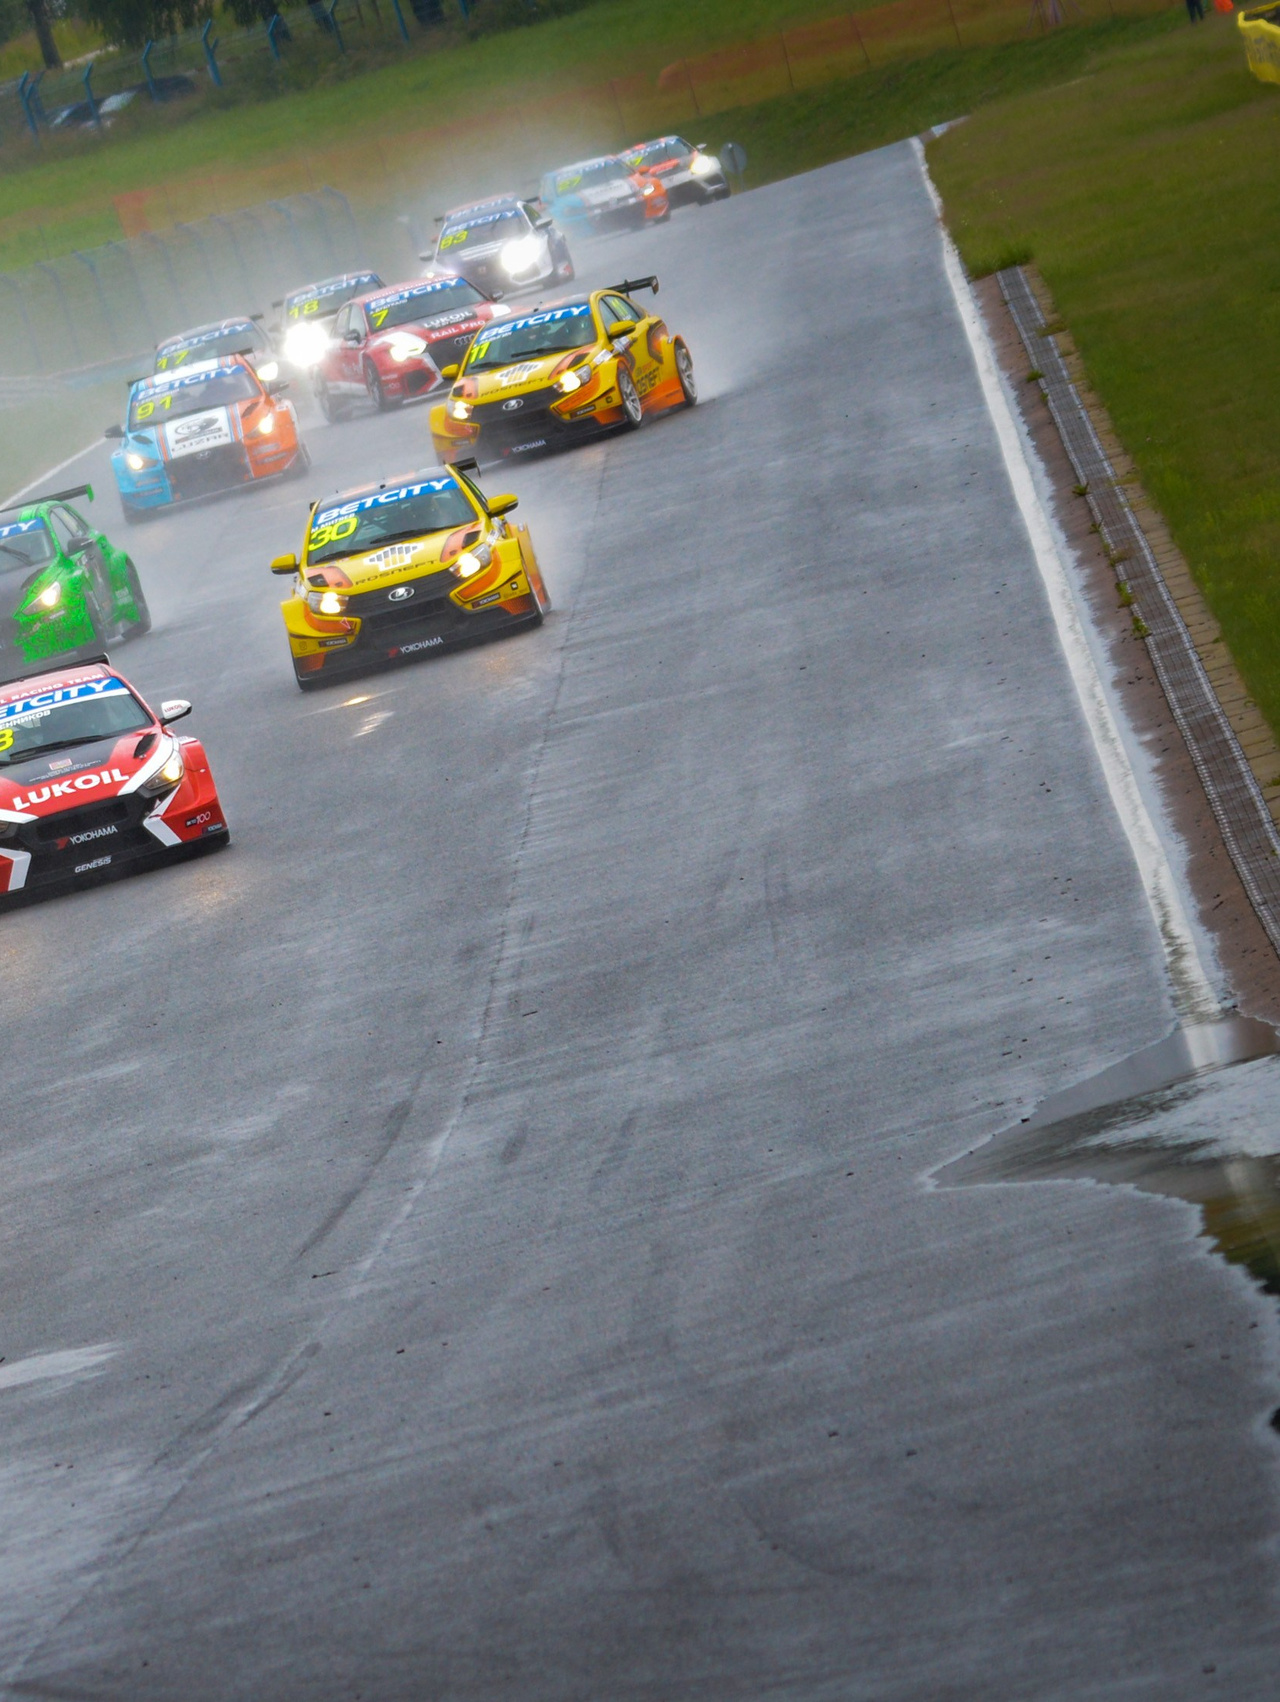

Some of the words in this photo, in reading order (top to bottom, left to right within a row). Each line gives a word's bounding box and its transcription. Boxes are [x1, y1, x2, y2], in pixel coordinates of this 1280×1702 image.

[440, 229, 469, 250] 83
[370, 278, 459, 310] BETCITY
[289, 299, 319, 319] 18
[372, 307, 389, 328] 7
[423, 310, 473, 328] LUKOIL
[431, 328, 459, 340] RAIL
[460, 320, 485, 332] PRO
[480, 305, 588, 341] BETCITY
[157, 350, 190, 370] 17
[470, 341, 491, 364] 11
[138, 364, 238, 400] BETCITY
[480, 377, 547, 397] ROSNEFT
[136, 395, 173, 421] 91
[512, 439, 547, 454] YOKOHAMA
[317, 478, 452, 525] BETCITY
[308, 516, 359, 551] 30
[355, 560, 438, 585] ROSNEFT
[399, 636, 444, 654] YOKOHAMA
[11, 683, 64, 701] RACING
[67, 673, 105, 685] TEAM
[13, 768, 130, 811] LUKOIL
[70, 825, 119, 846] YOKOHAMA
[74, 855, 112, 874] GENESIS
